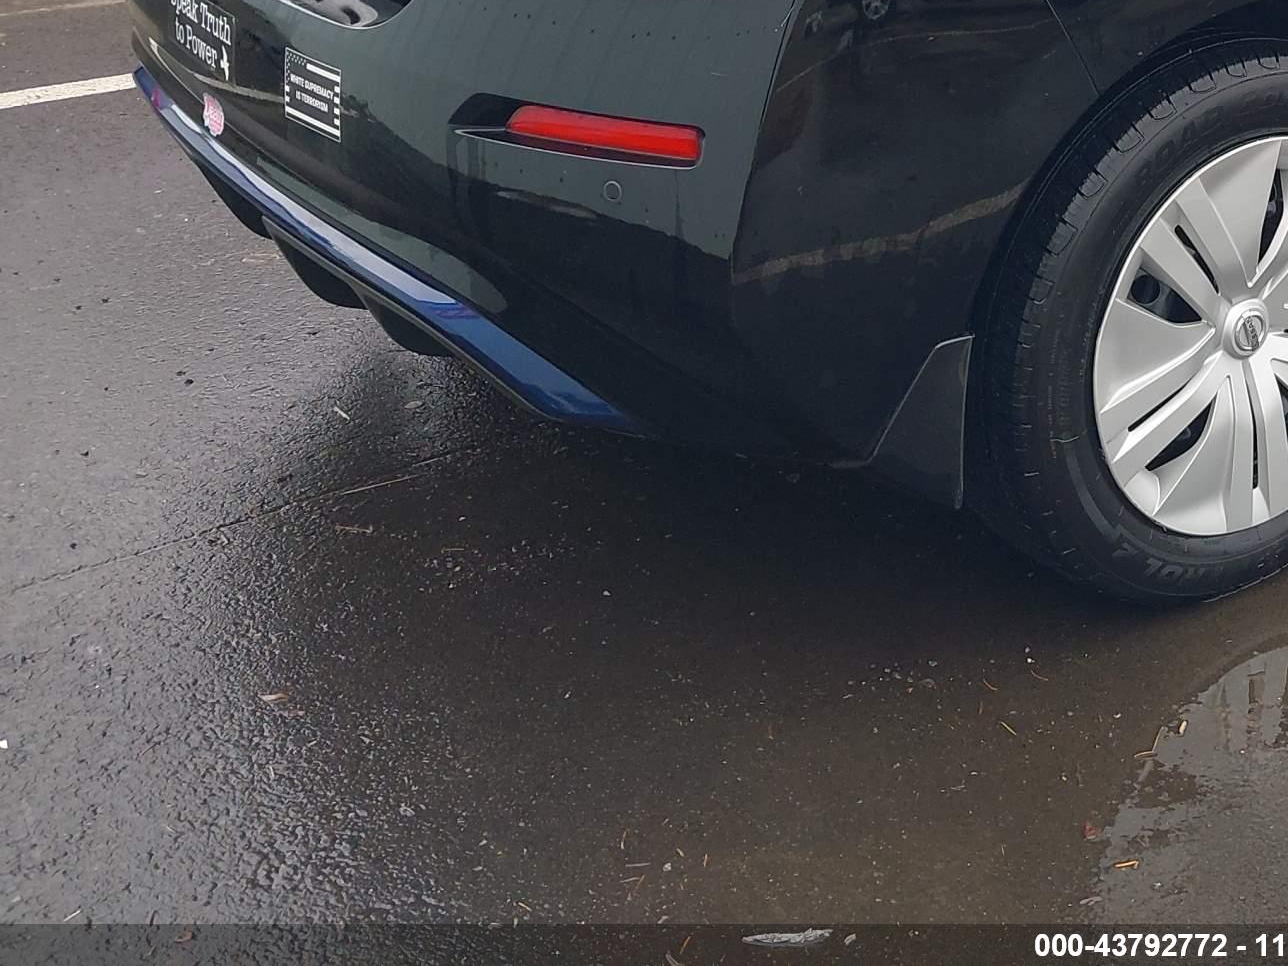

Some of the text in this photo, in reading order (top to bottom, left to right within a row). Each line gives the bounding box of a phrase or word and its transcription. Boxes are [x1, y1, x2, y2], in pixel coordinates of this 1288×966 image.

[174, 15, 218, 69] to Power
[200, 1, 232, 47] Truth
[304, 79, 334, 101] SUPREMACY
